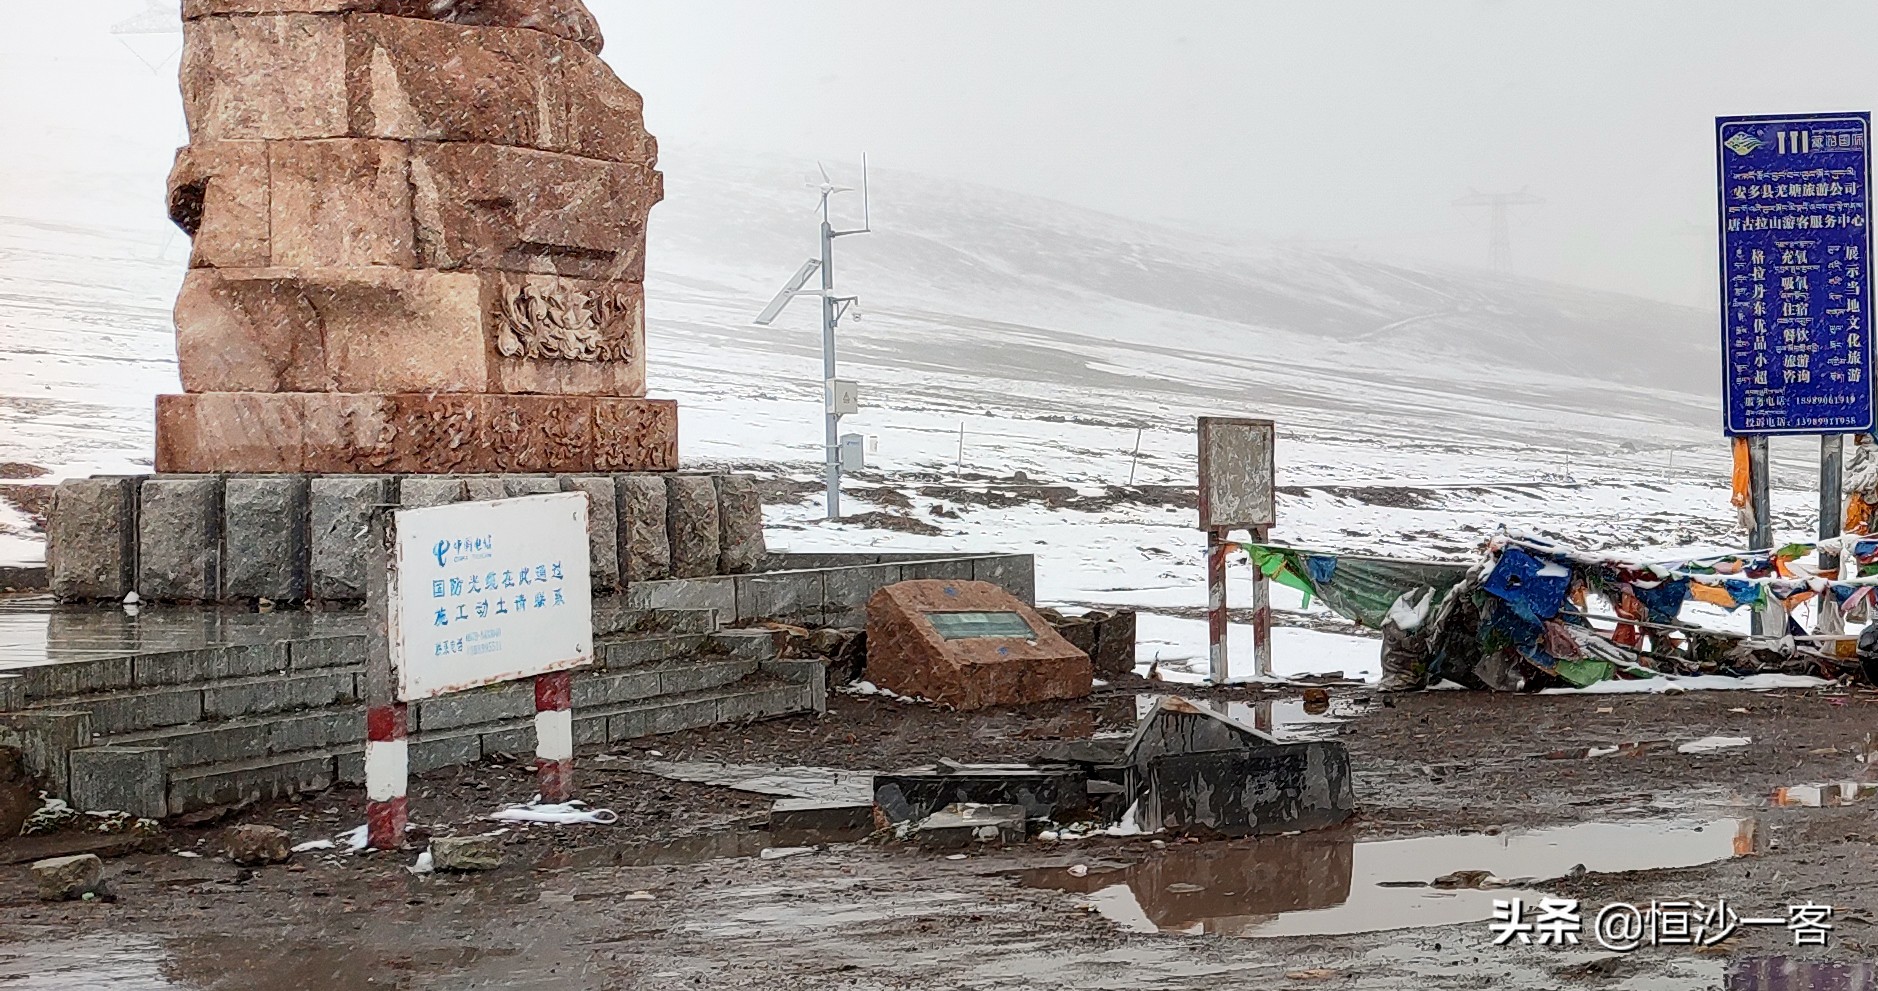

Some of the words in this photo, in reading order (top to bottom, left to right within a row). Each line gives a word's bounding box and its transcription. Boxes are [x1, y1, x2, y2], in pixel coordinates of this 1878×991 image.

[1733, 181, 1858, 199] 安多县羌塘旅游公司
[1728, 213, 1864, 231] 唐古拉山游客服务中心
[1781, 250, 1808, 264] 充氧
[1781, 276, 1808, 290] 吸氧
[1782, 302, 1809, 316] 住宿
[1846, 246, 1862, 383] 展示当地文化旅游
[1784, 354, 1810, 368] 旅游
[432, 560, 564, 598] 国防光缆在此通过
[434, 588, 565, 627] 施工动土请联系
